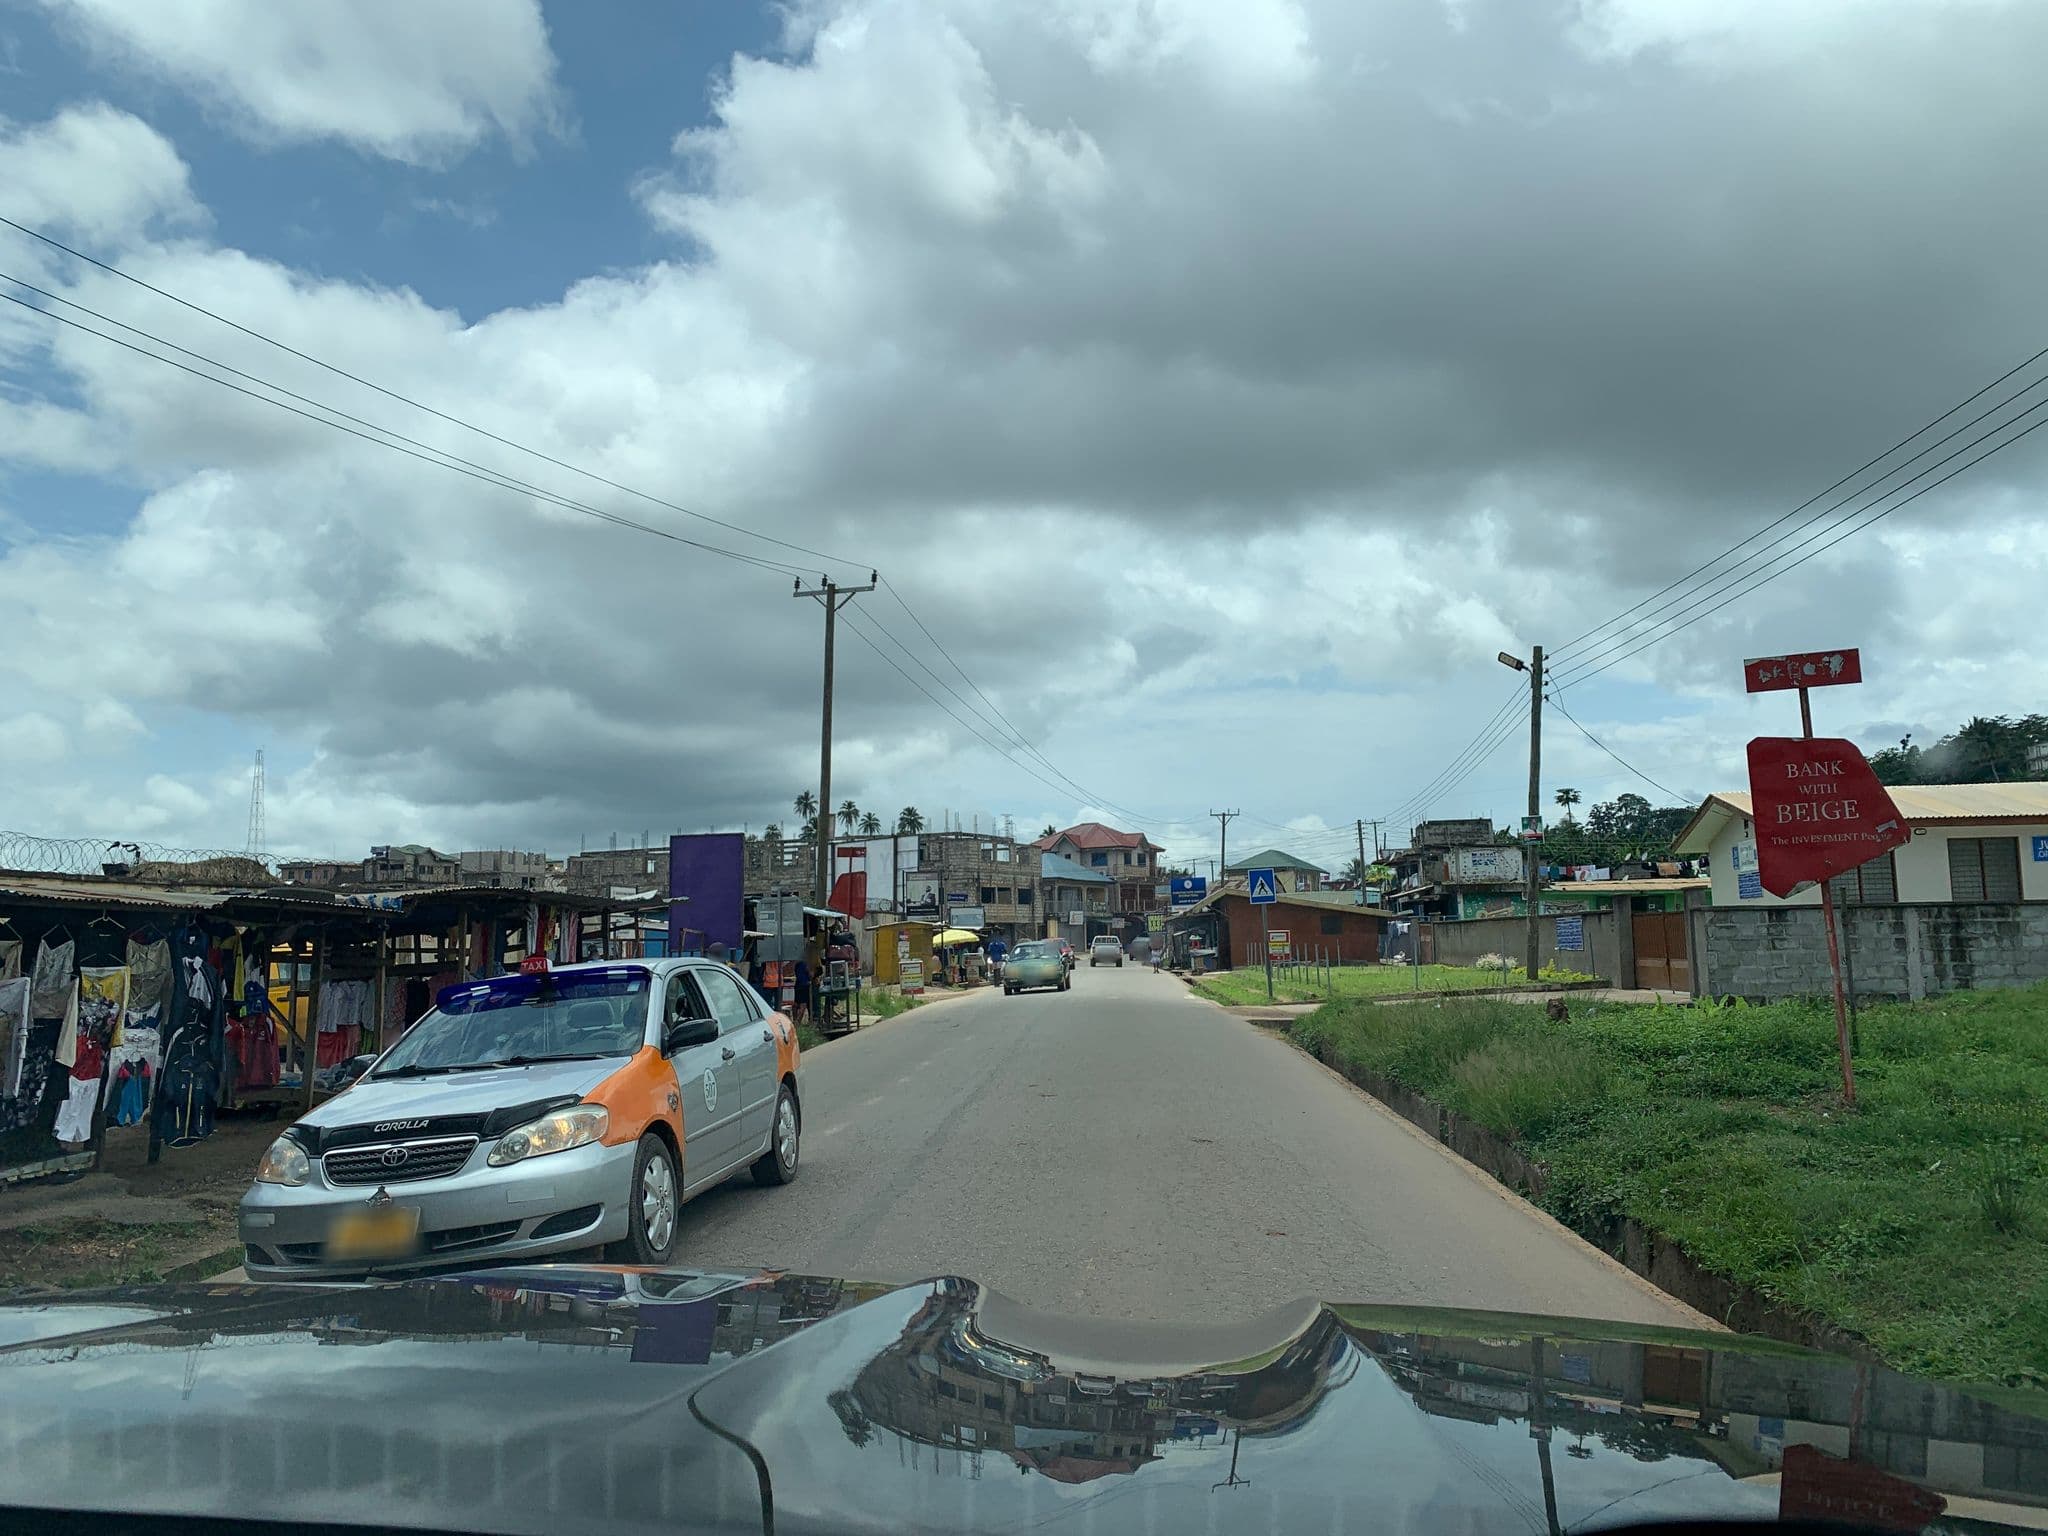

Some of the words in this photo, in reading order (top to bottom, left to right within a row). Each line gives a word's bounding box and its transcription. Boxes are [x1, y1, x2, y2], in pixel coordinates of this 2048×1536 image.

[1786, 760, 1845, 779] BANK
[1799, 783, 1838, 796] WITH
[1776, 799, 1860, 824] BEIGE
[1771, 836, 1789, 846] The
[1791, 832, 1858, 846] INVESTMENT
[521, 960, 546, 970] TAXI
[374, 1120, 429, 1132] COROLLA
